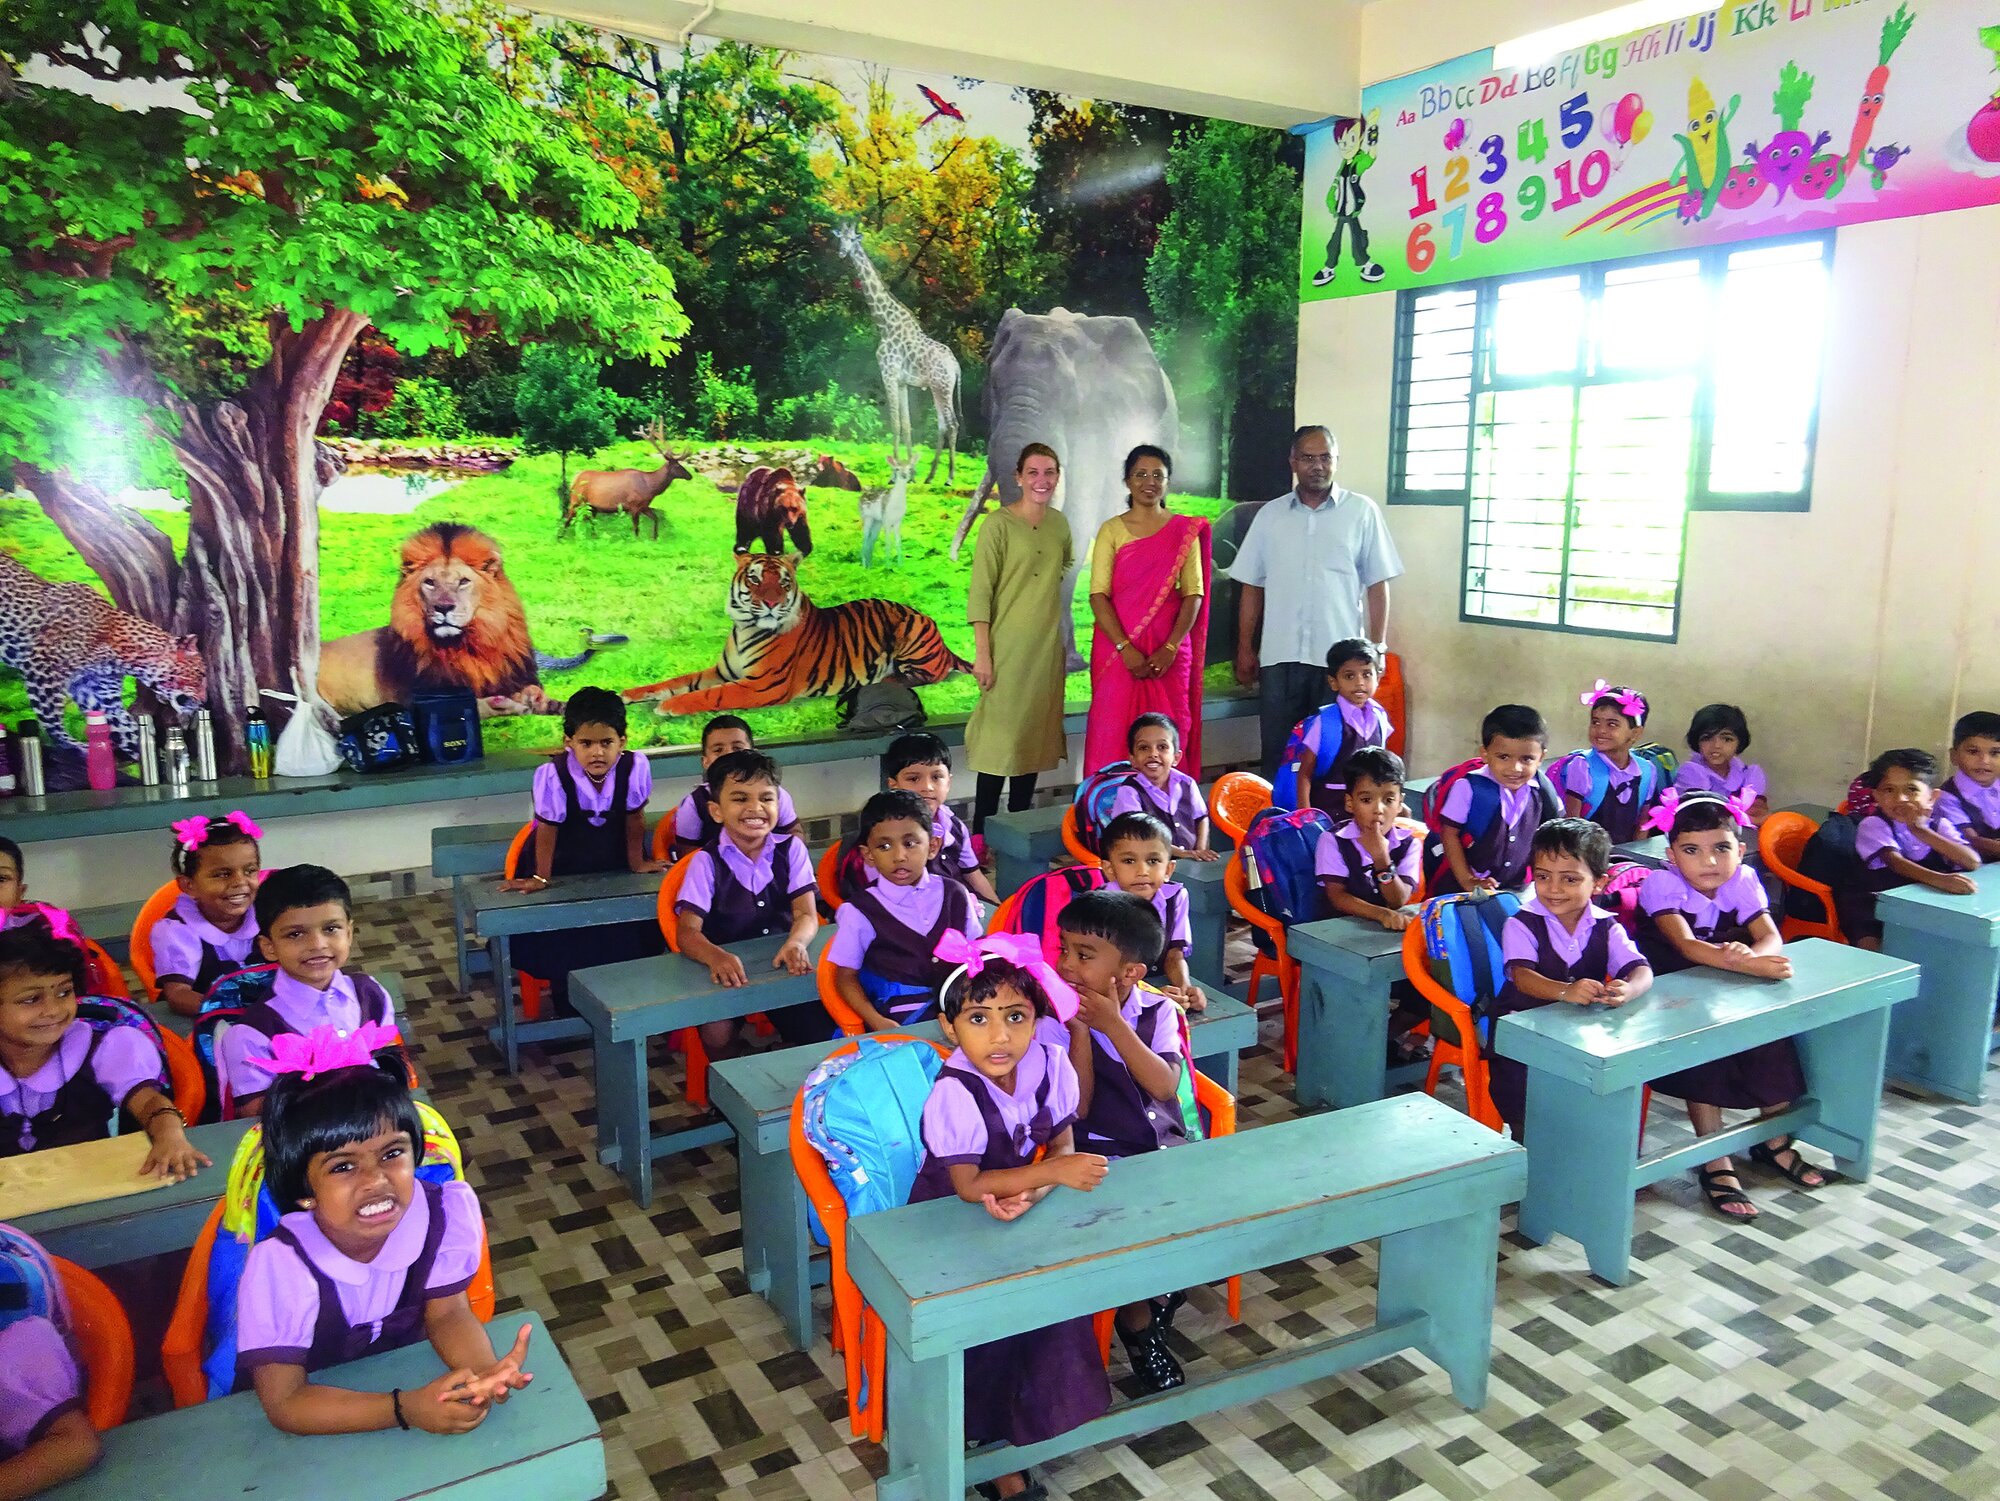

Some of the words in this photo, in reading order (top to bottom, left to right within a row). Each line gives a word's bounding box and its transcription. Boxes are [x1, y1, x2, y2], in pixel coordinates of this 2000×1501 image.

[1396, 110, 1416, 127] Aa
[1419, 84, 1452, 119] Bb
[1455, 86, 1475, 110] Cc
[1479, 74, 1519, 105] Dd
[1584, 44, 1618, 79] Gg
[1622, 29, 1663, 68] Hh
[1689, 11, 1716, 52] Jj
[1731, 0, 1779, 37] Kk
[1406, 222, 1436, 274] 6
[1442, 203, 1467, 261] 7
[1475, 191, 1508, 244] 8
[1517, 175, 1547, 221] 9
[1551, 149, 1611, 212] 10
[1408, 165, 1437, 220] 1
[1443, 154, 1470, 203] 2
[1478, 134, 1508, 184] 3
[1517, 118, 1549, 164] 4
[1560, 91, 1594, 149] 5
